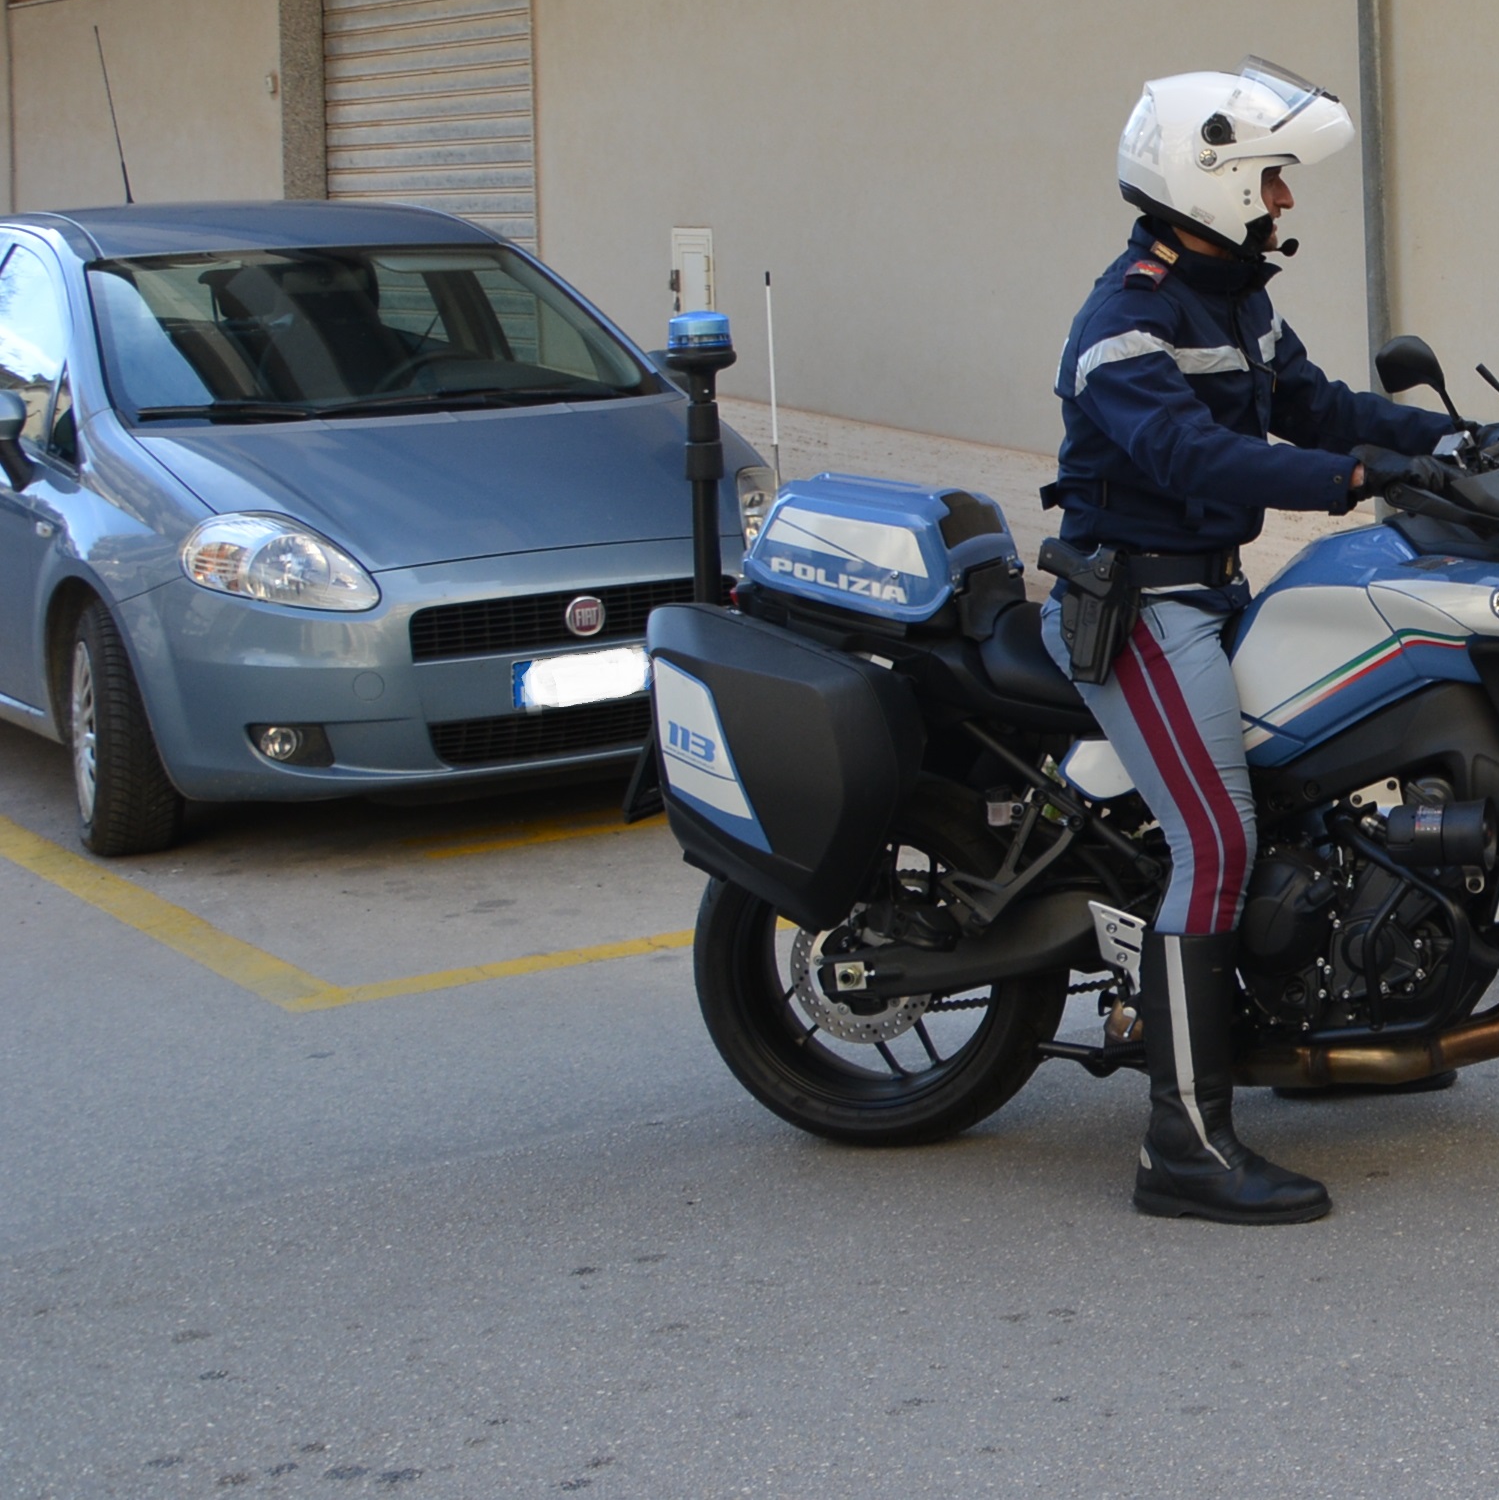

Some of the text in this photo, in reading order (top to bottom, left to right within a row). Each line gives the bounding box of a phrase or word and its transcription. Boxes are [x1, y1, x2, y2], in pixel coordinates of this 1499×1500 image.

[771, 556, 907, 604] POLIZIA
[575, 607, 598, 627] FIAT
[668, 720, 716, 763] 113
